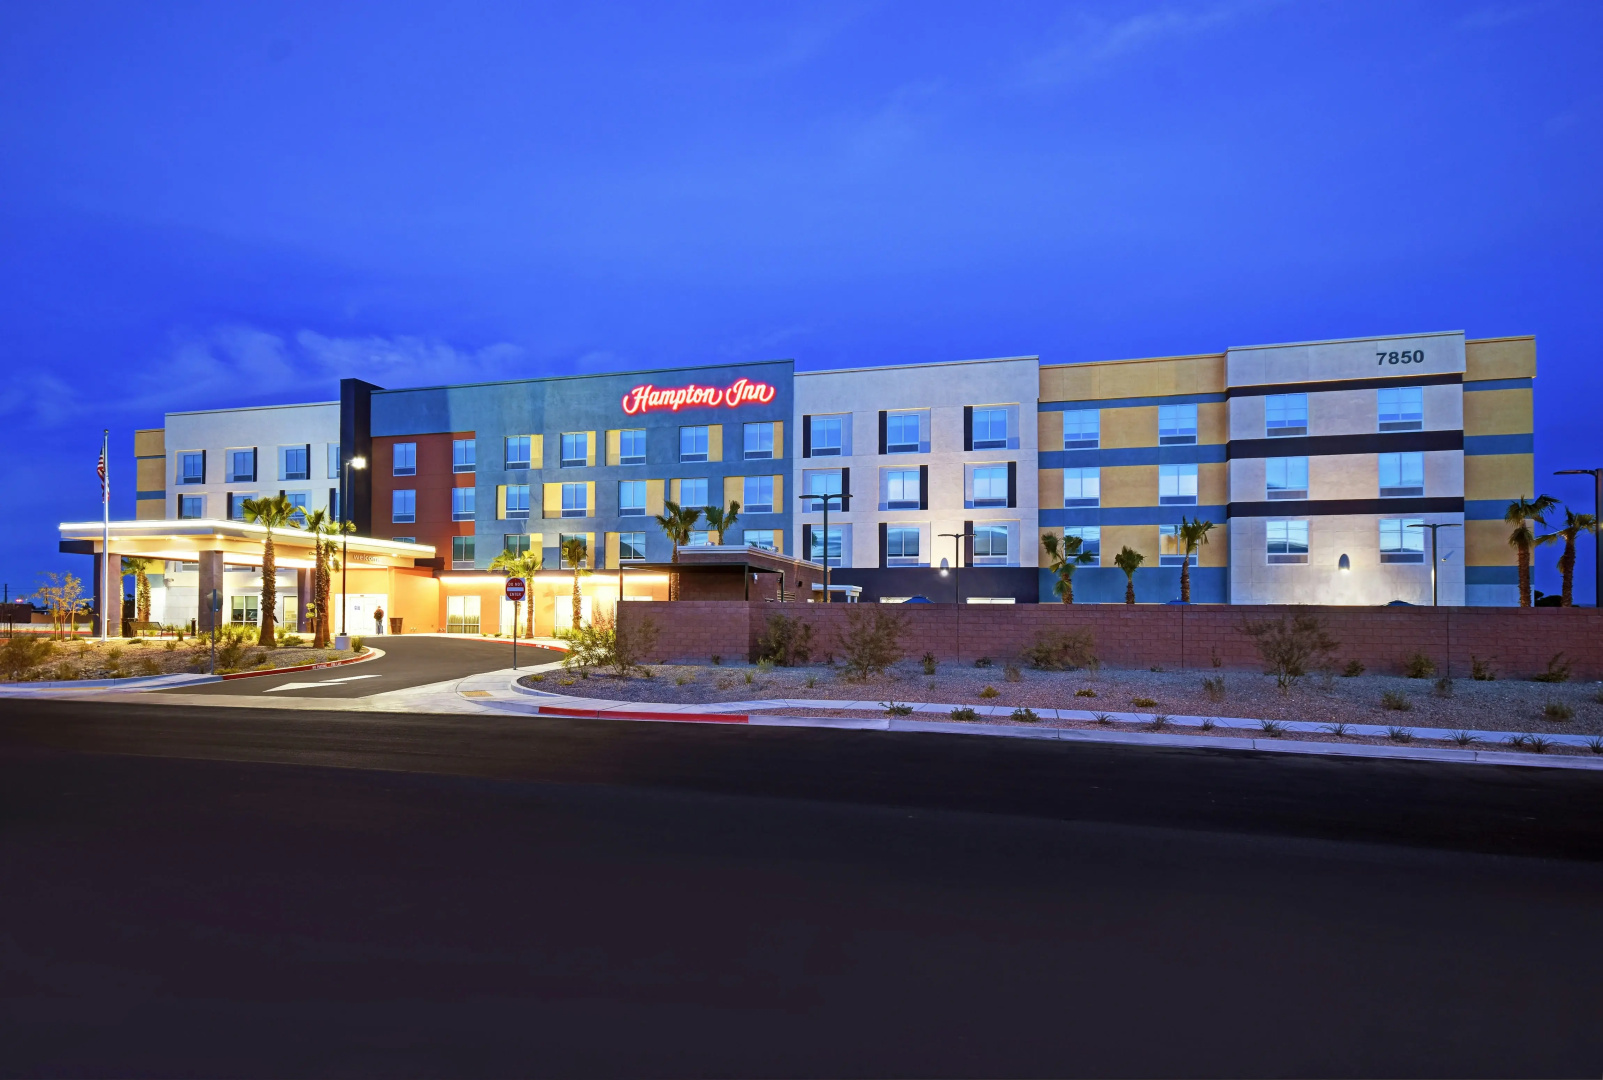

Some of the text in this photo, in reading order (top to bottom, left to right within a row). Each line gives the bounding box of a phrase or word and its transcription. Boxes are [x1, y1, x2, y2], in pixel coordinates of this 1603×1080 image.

[1376, 349, 1425, 366] 7850
[622, 378, 775, 414] Hampton Inn
